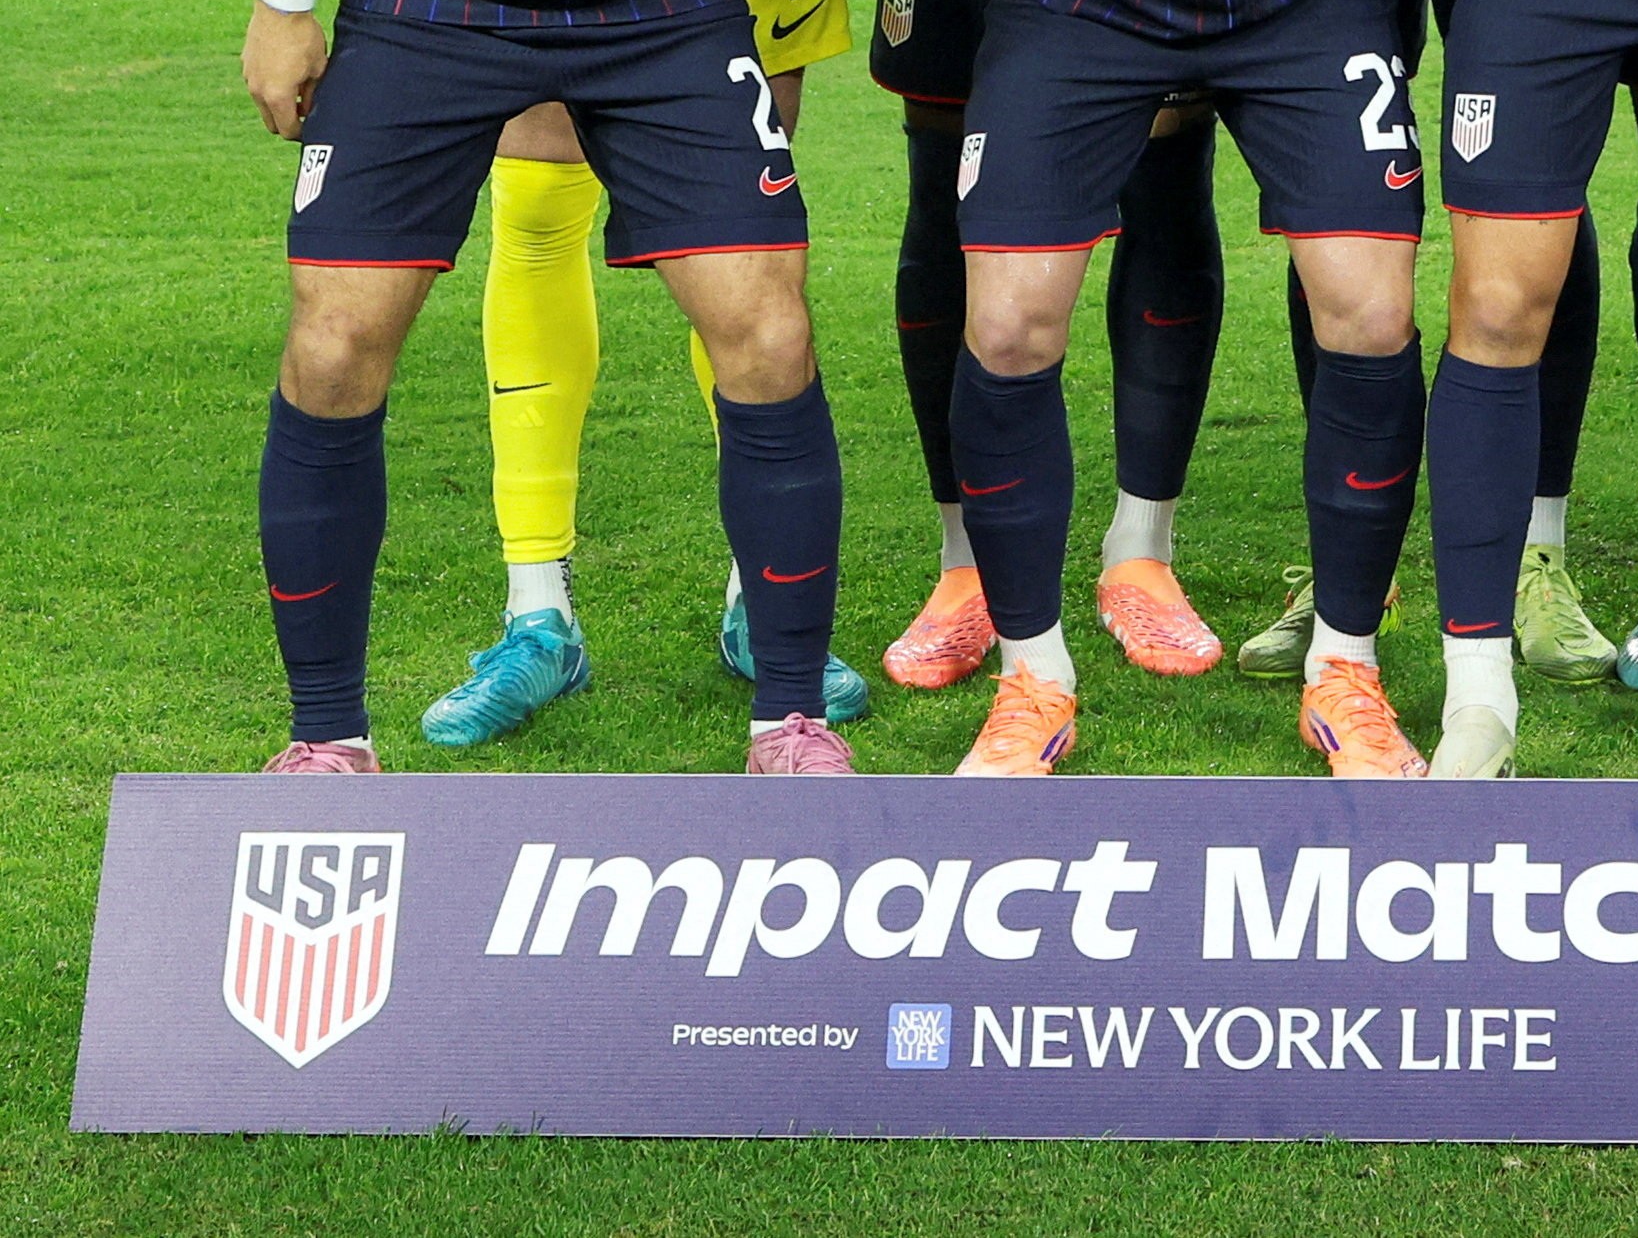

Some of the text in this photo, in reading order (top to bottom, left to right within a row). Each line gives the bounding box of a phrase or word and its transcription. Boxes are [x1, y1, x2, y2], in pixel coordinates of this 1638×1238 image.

[726, 55, 790, 151] 2
[1343, 52, 1420, 152] 2
[1457, 97, 1492, 123] USA
[245, 844, 393, 930] USA
[484, 841, 1158, 977] Impact
[672, 1023, 859, 1050] Presented by
[891, 1026, 945, 1045] YORK
[898, 1010, 942, 1028] NEW
[970, 1006, 1556, 1070] NEW YORK LIFE
[896, 1043, 939, 1061] LIFE
